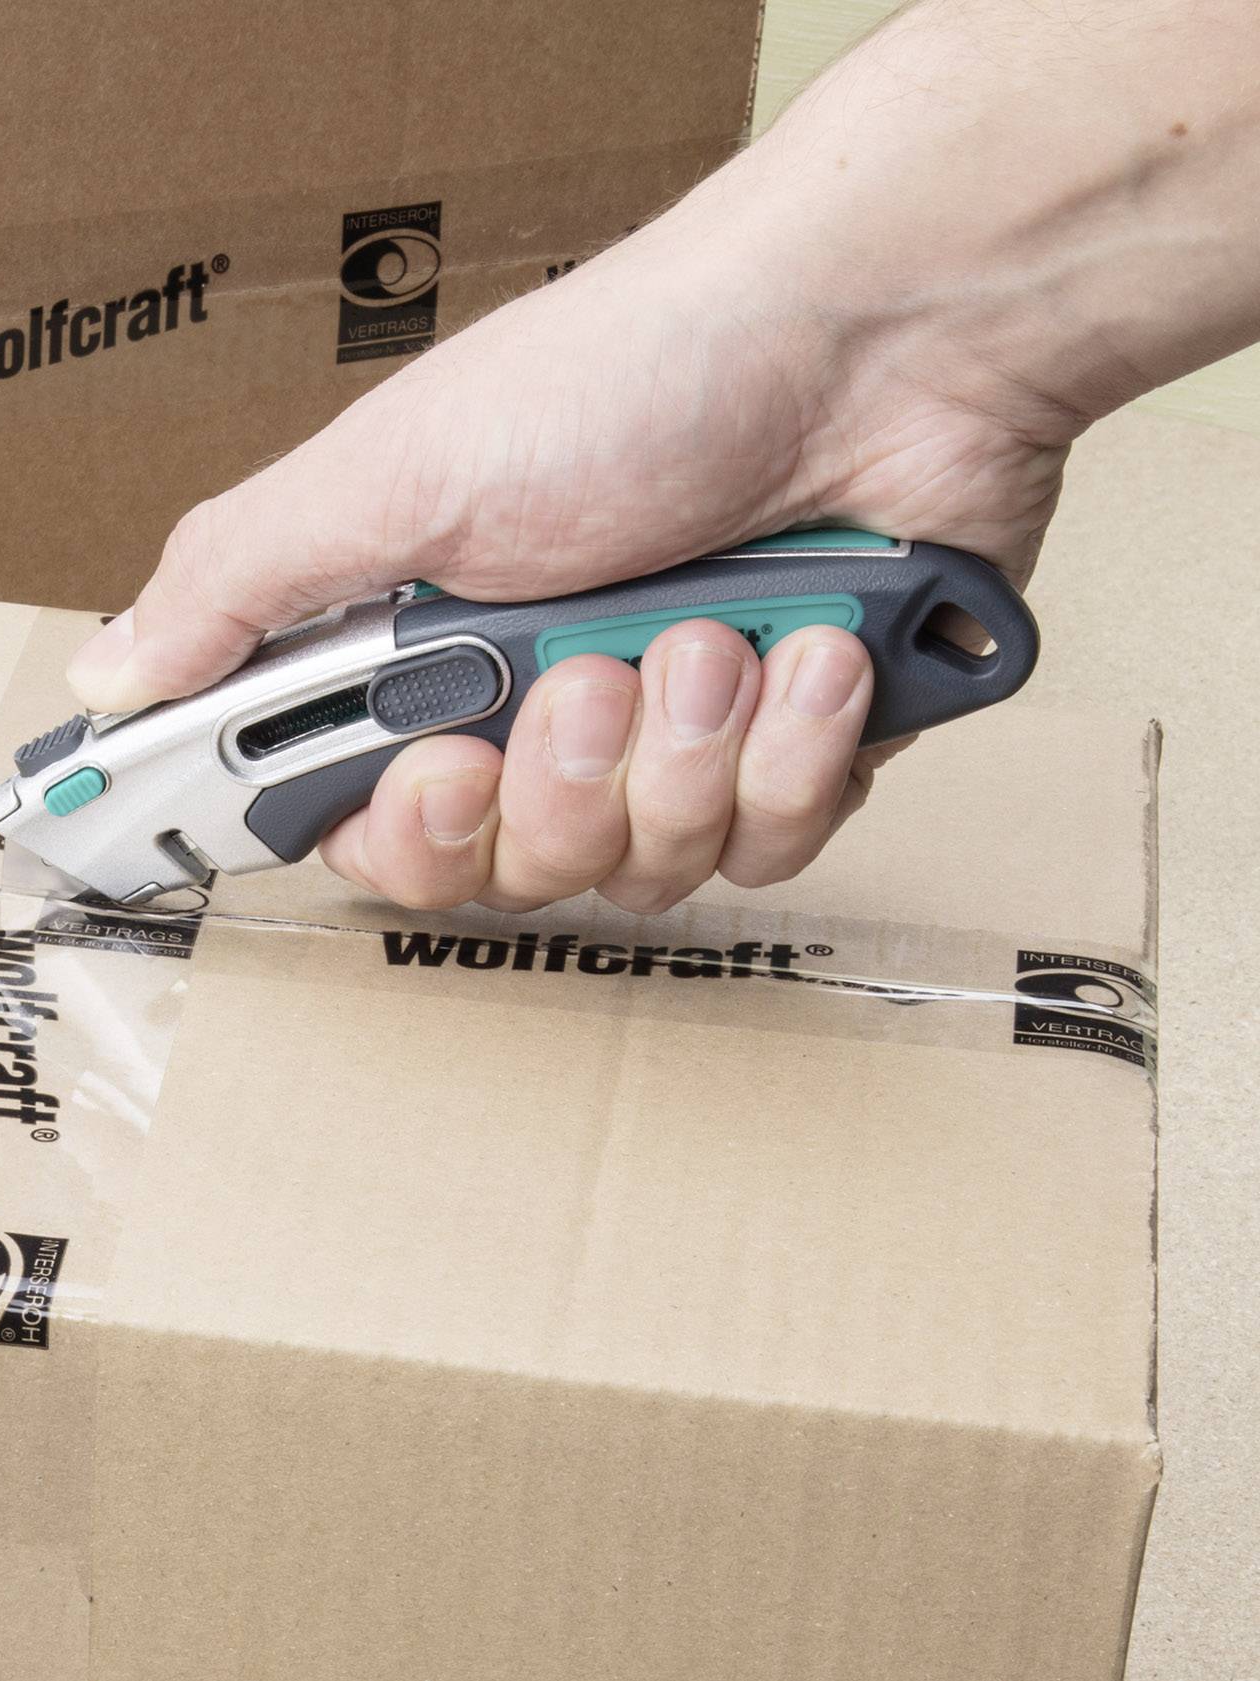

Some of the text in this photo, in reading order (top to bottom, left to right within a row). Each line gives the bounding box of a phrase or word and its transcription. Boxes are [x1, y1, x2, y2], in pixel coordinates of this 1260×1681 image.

[346, 207, 438, 230] INTERSEROH
[348, 315, 429, 339] VERTRAGS
[52, 919, 183, 943] VERTRAGS
[21, 1238, 60, 1343] INTERSEROH
